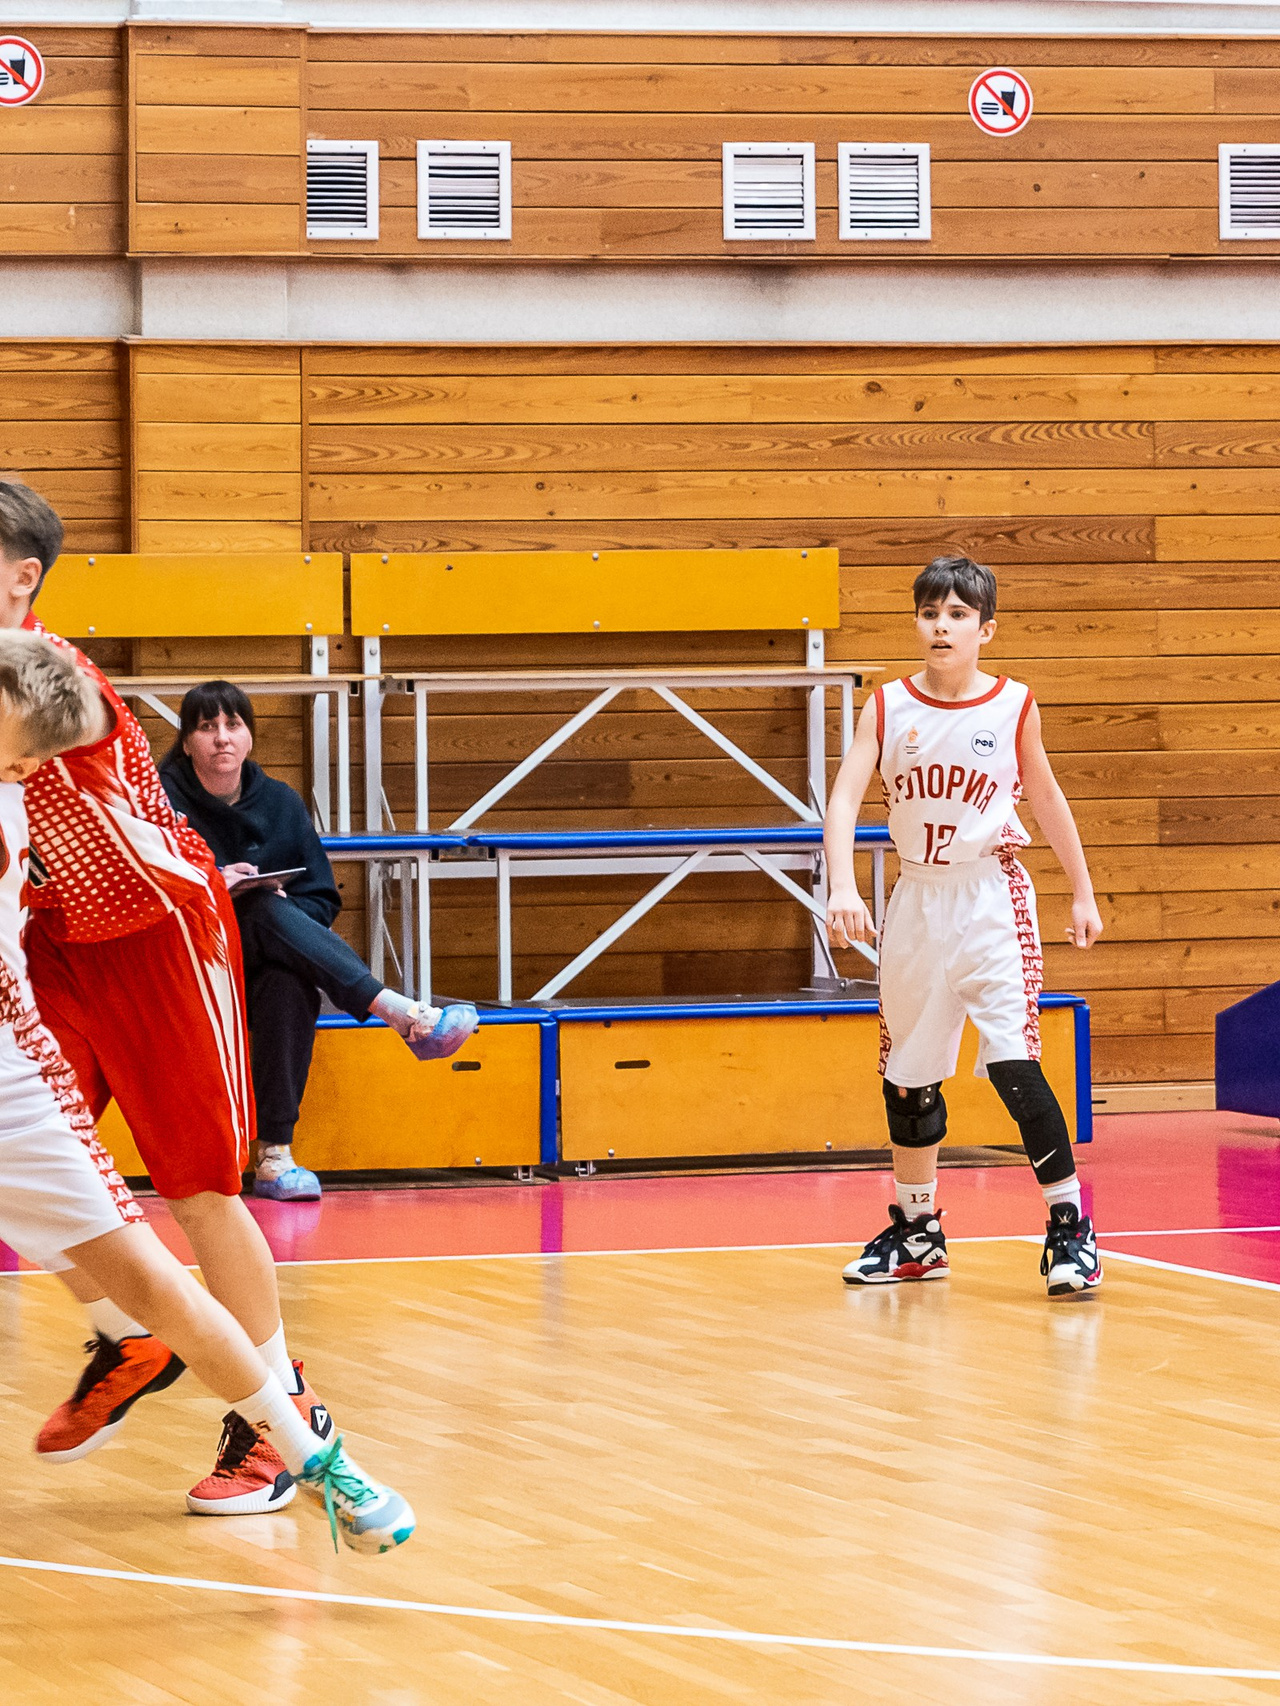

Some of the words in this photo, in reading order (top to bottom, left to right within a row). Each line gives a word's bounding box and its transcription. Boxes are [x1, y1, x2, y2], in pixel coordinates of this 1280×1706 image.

[974, 738, 994, 748] РФБ
[923, 822, 957, 866] 12
[910, 1193, 930, 1204] 12
